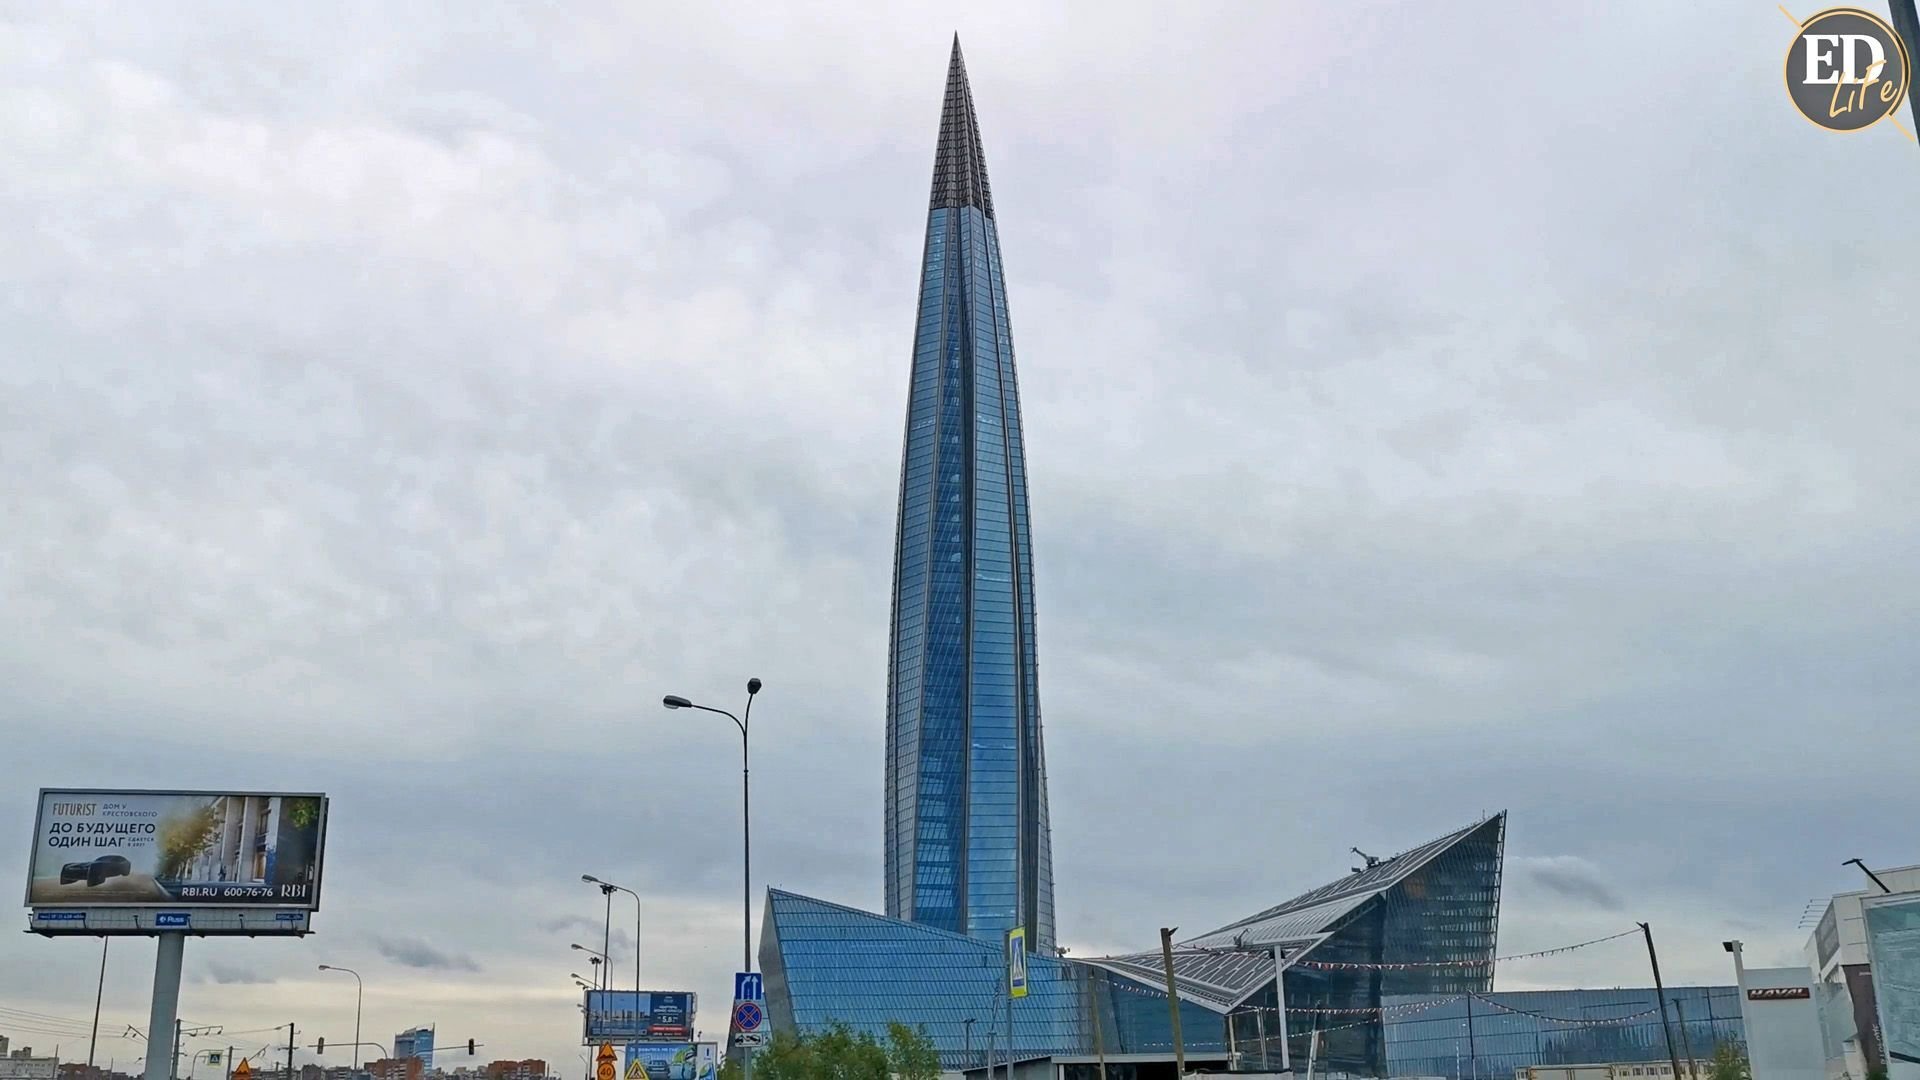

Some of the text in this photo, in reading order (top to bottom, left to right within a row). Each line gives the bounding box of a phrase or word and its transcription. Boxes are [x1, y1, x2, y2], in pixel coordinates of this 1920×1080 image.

[52, 803, 97, 816] FUTURIST
[49, 822, 156, 835] ДО БУДУЩЕГО
[48, 836, 125, 849] ОДИН ШАГ
[182, 884, 307, 898] RBI.RU 600-76-76 RBI
[1751, 988, 1807, 998] HAVAL
[600, 1067, 612, 1077] 40
